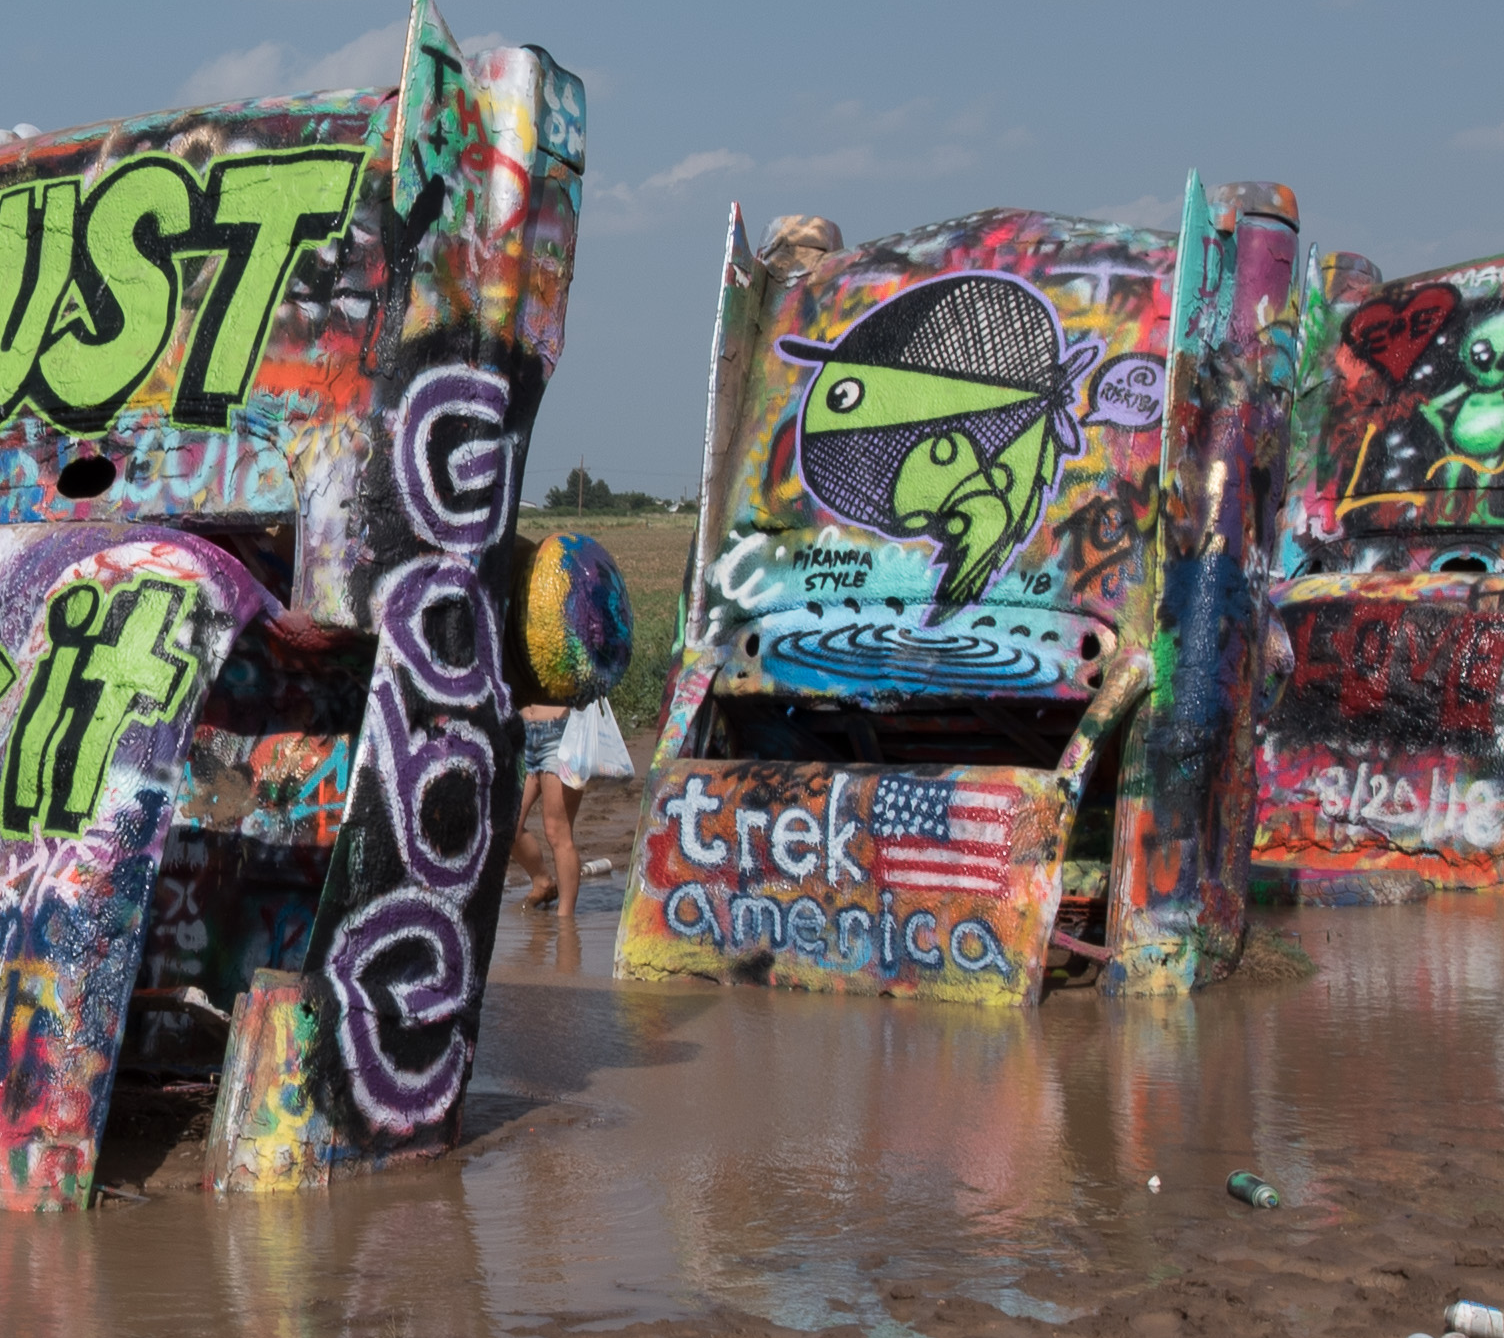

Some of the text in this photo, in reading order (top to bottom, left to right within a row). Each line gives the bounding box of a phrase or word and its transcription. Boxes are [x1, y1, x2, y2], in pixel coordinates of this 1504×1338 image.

[803, 570, 867, 592] STYLE
[663, 772, 867, 887] trek
[664, 882, 1012, 982] america
